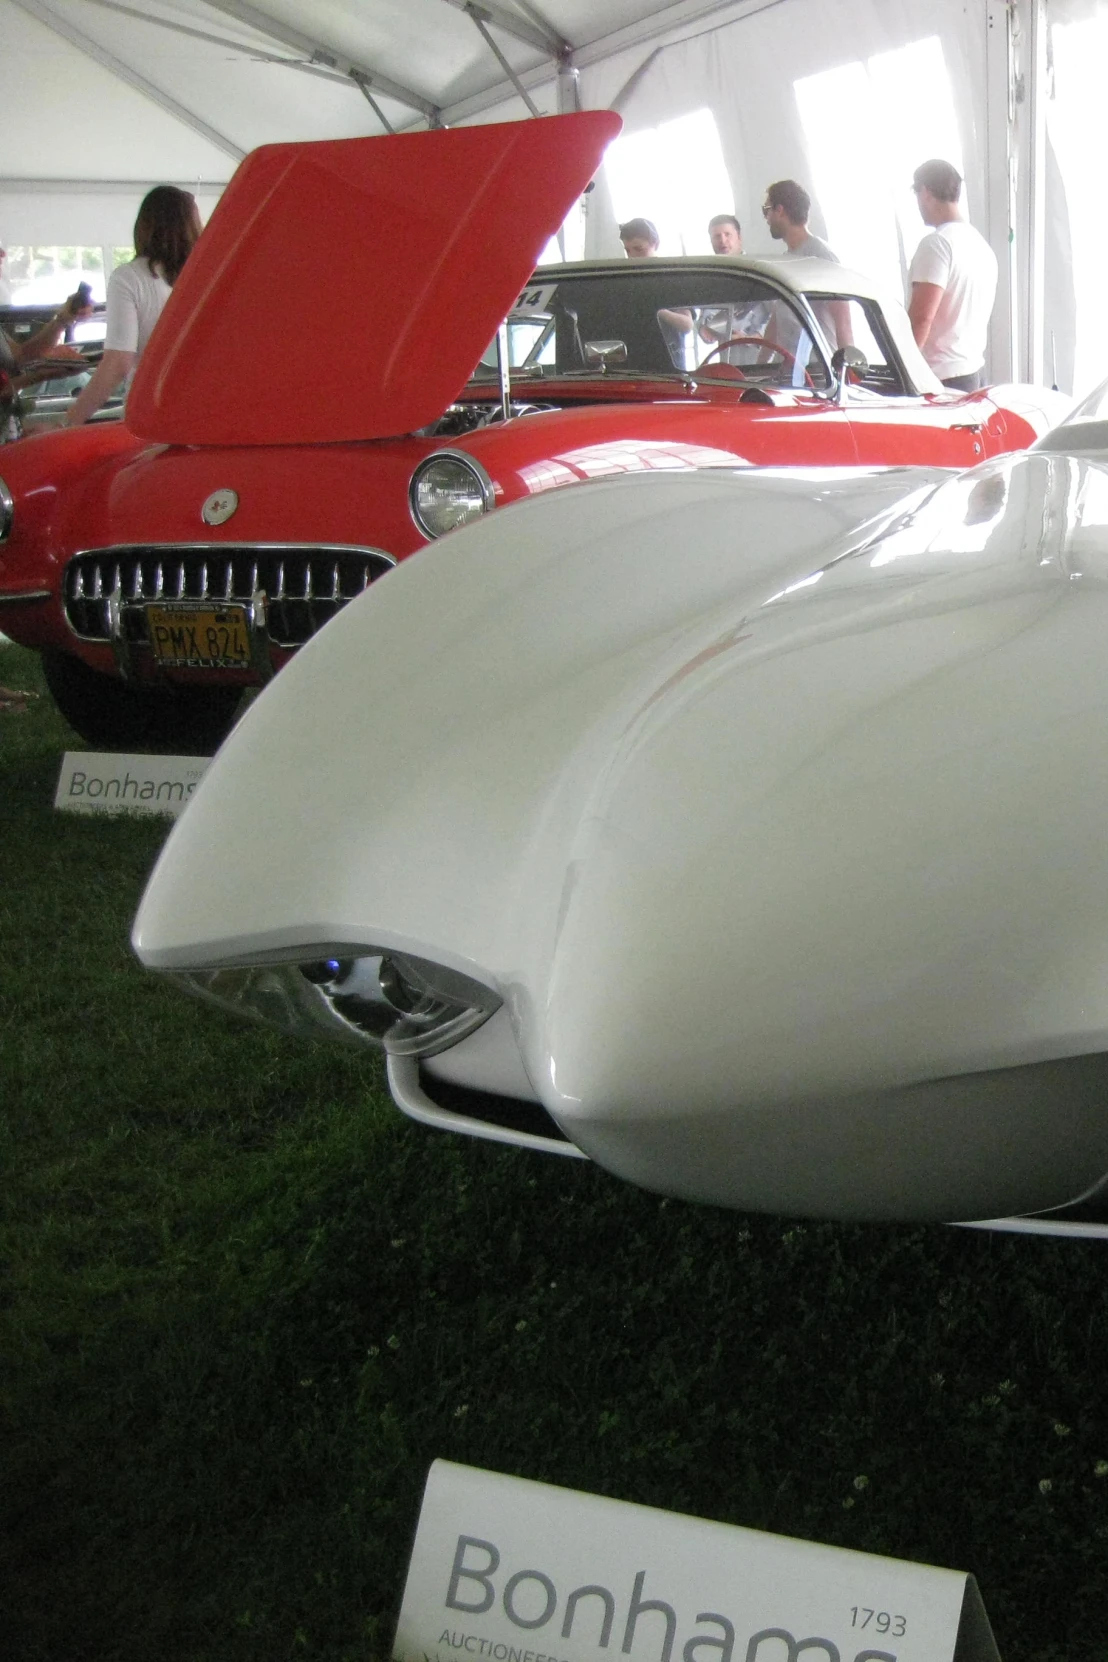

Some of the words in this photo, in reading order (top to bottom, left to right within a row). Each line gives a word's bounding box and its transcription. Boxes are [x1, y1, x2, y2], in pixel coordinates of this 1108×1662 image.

[155, 626, 202, 658] PMX
[206, 627, 246, 659] 824
[176, 658, 227, 668] FELIX
[445, 1534, 898, 1662] Bonham
[850, 1606, 907, 1637] 1793
[438, 1629, 570, 1662] AUCTIONEE
